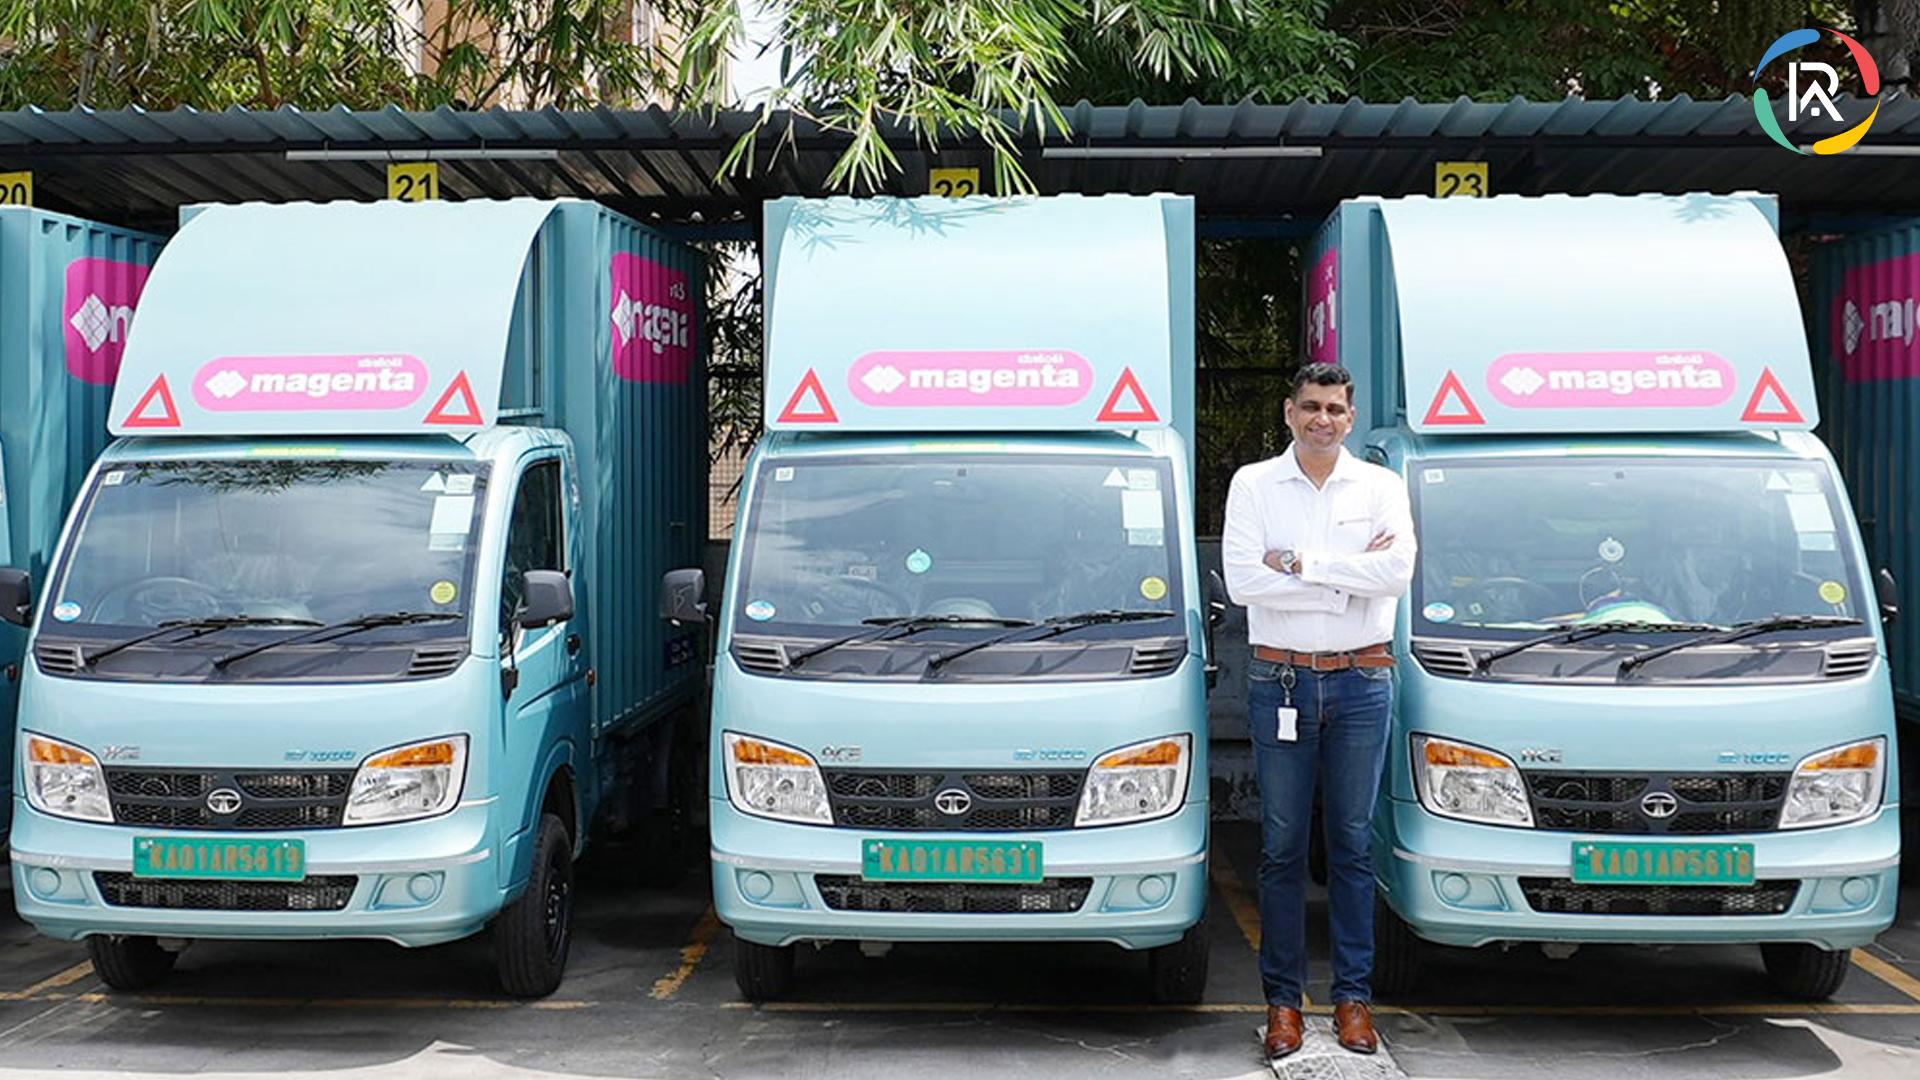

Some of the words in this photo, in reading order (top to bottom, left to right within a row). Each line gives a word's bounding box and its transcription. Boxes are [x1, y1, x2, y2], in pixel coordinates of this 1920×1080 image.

[394, 173, 432, 203] 21
[934, 178, 974, 198] 22
[1440, 172, 1483, 199] 23
[249, 368, 416, 398] magenta
[908, 363, 1079, 395] magenta
[1547, 364, 1723, 395] magenta
[1039, 749, 1087, 761] 1000
[150, 843, 300, 873] KA01AR5619
[880, 846, 1036, 875] KA01AR5631
[1591, 849, 1751, 877] KA01AR5618
